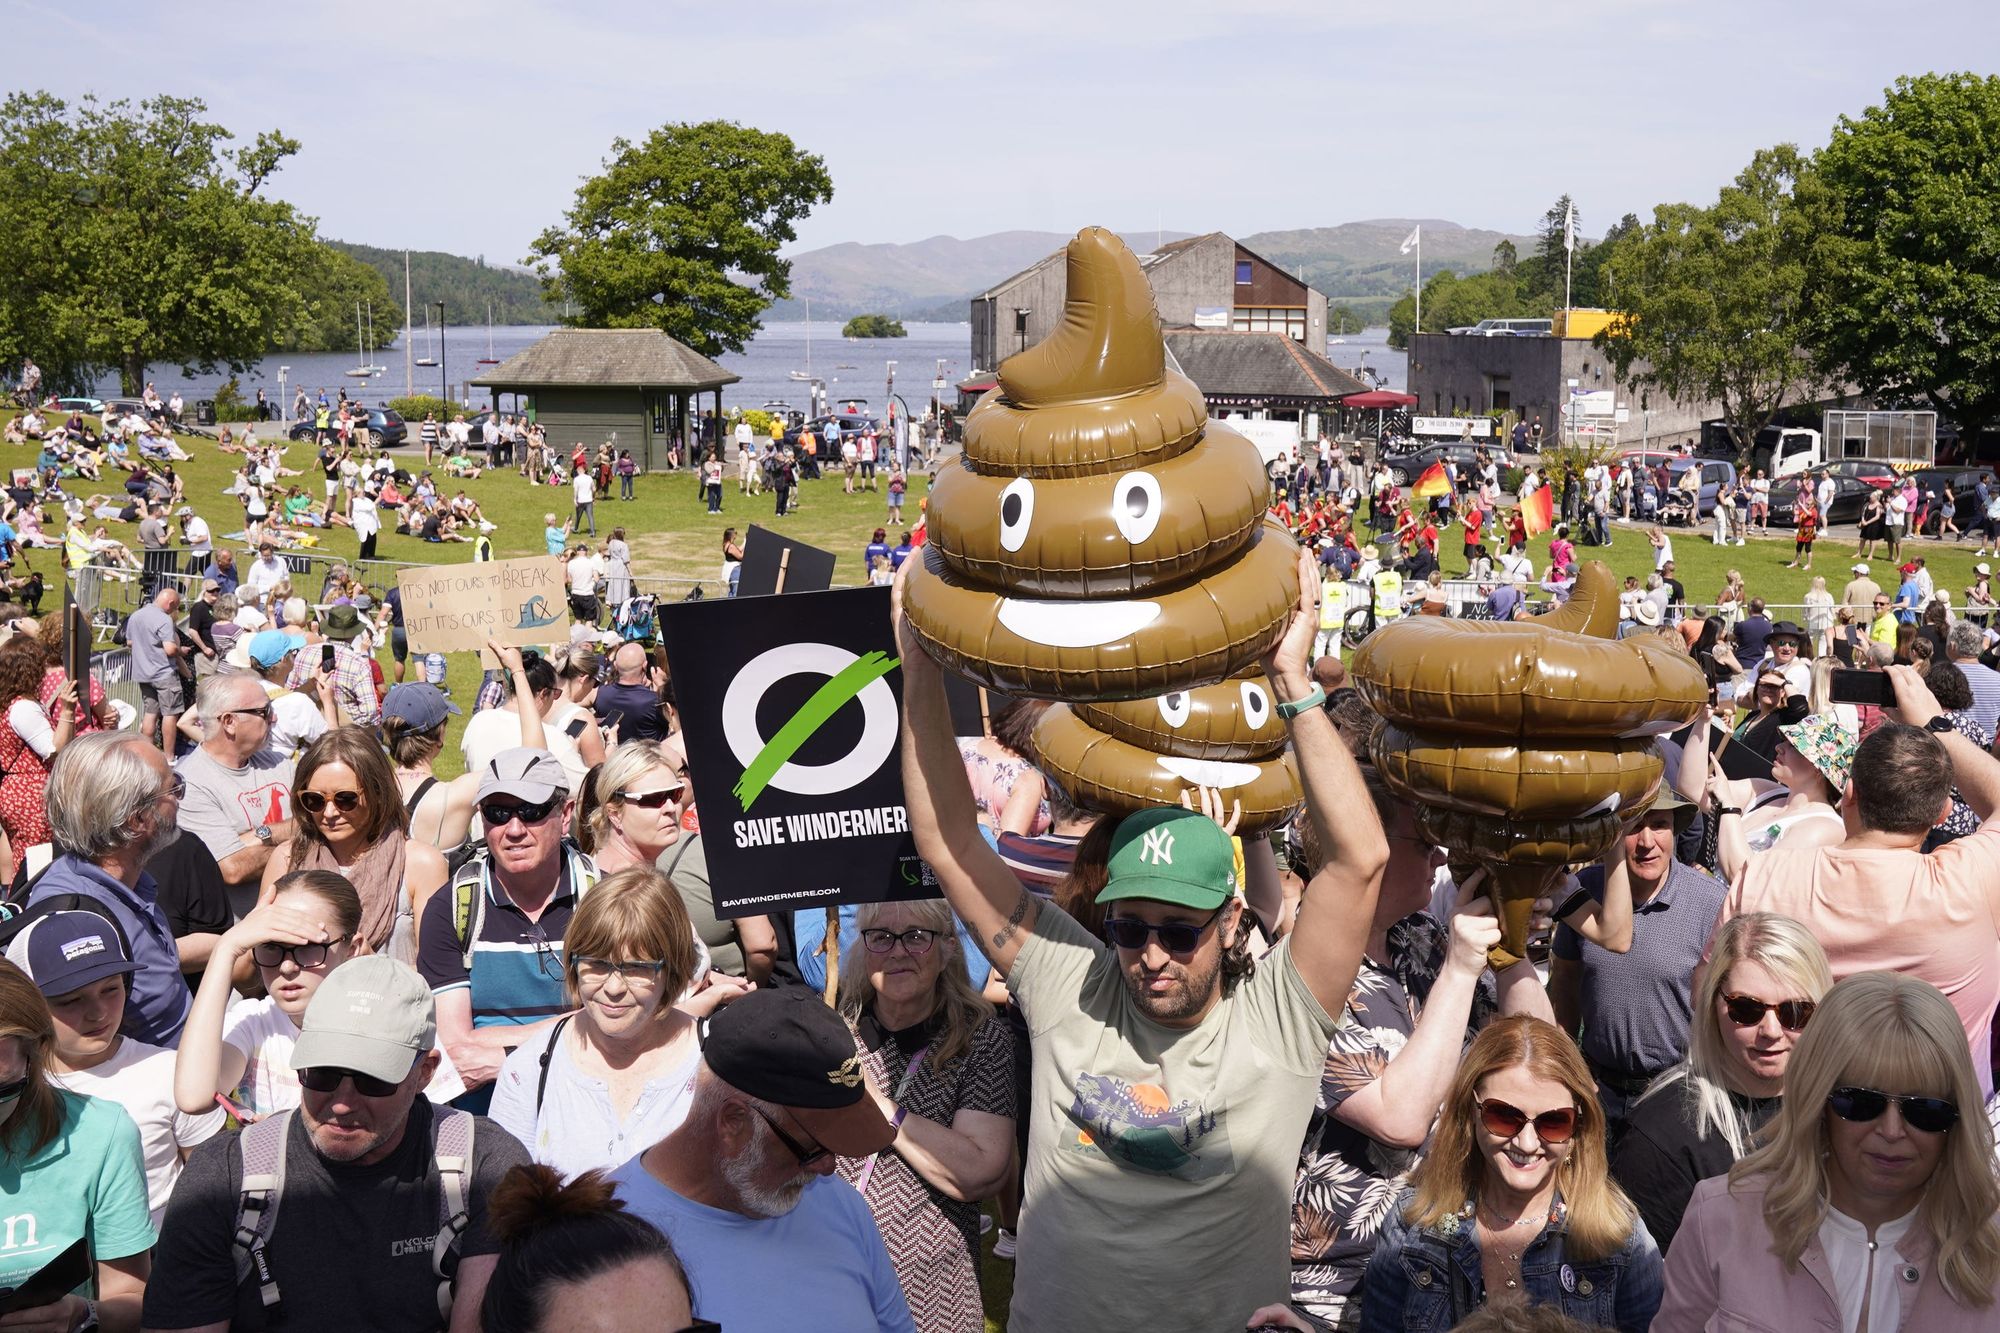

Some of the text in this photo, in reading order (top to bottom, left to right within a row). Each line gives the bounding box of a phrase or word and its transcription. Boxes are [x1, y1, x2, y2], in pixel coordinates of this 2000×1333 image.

[281, 556, 310, 573] XIT
[402, 567, 555, 601] IT'S NOT OURS TO BREAK
[405, 600, 552, 636] BUT IT'S OURS TO FIX
[733, 806, 912, 848] SAVE WINDERMER
[722, 888, 840, 907] SAVEWINDERMERE.COM
[65, 944, 106, 962] patagonia
[1114, 1078, 1189, 1115] MOUNTAINS
